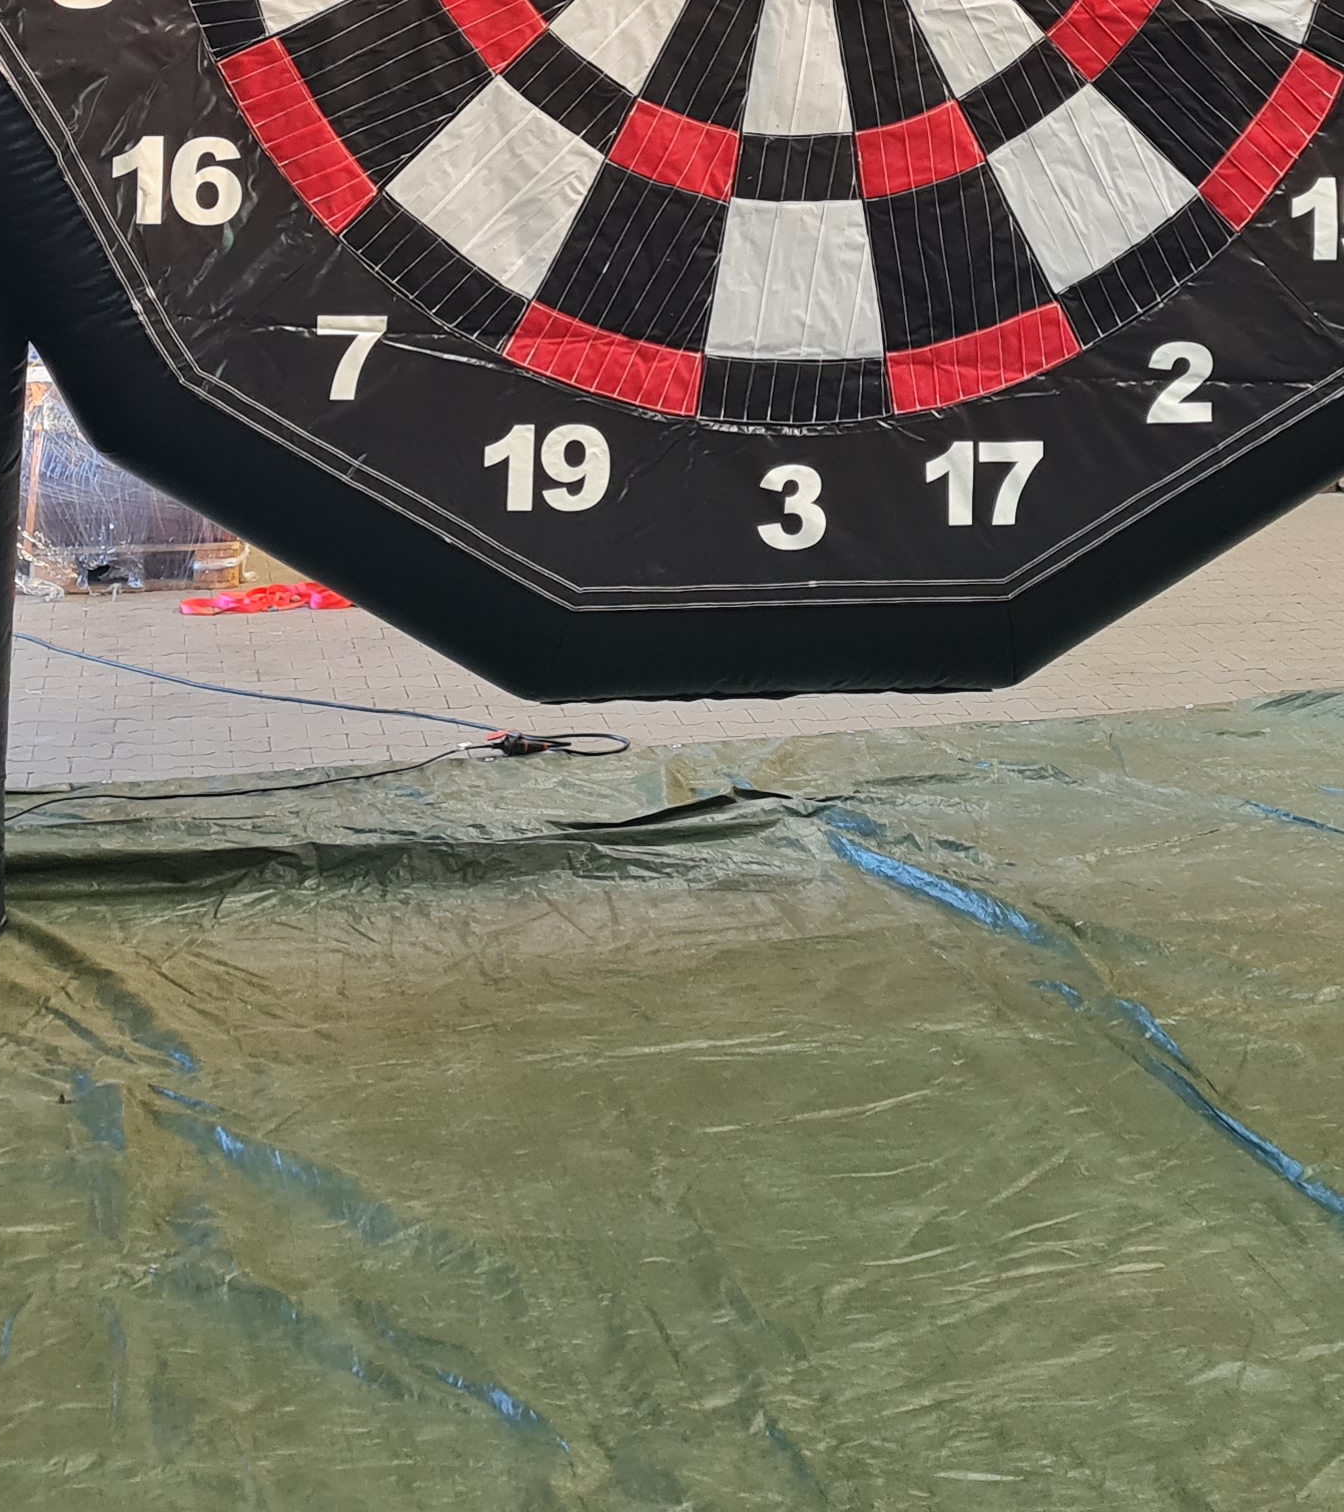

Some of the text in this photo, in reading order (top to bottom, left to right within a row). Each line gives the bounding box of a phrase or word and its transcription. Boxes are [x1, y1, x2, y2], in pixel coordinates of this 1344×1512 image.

[112, 136, 242, 225] 16
[313, 316, 387, 400] 7
[1147, 342, 1212, 423] 2
[484, 424, 610, 511] 19
[758, 465, 826, 550] 3
[926, 441, 1043, 525] 17
